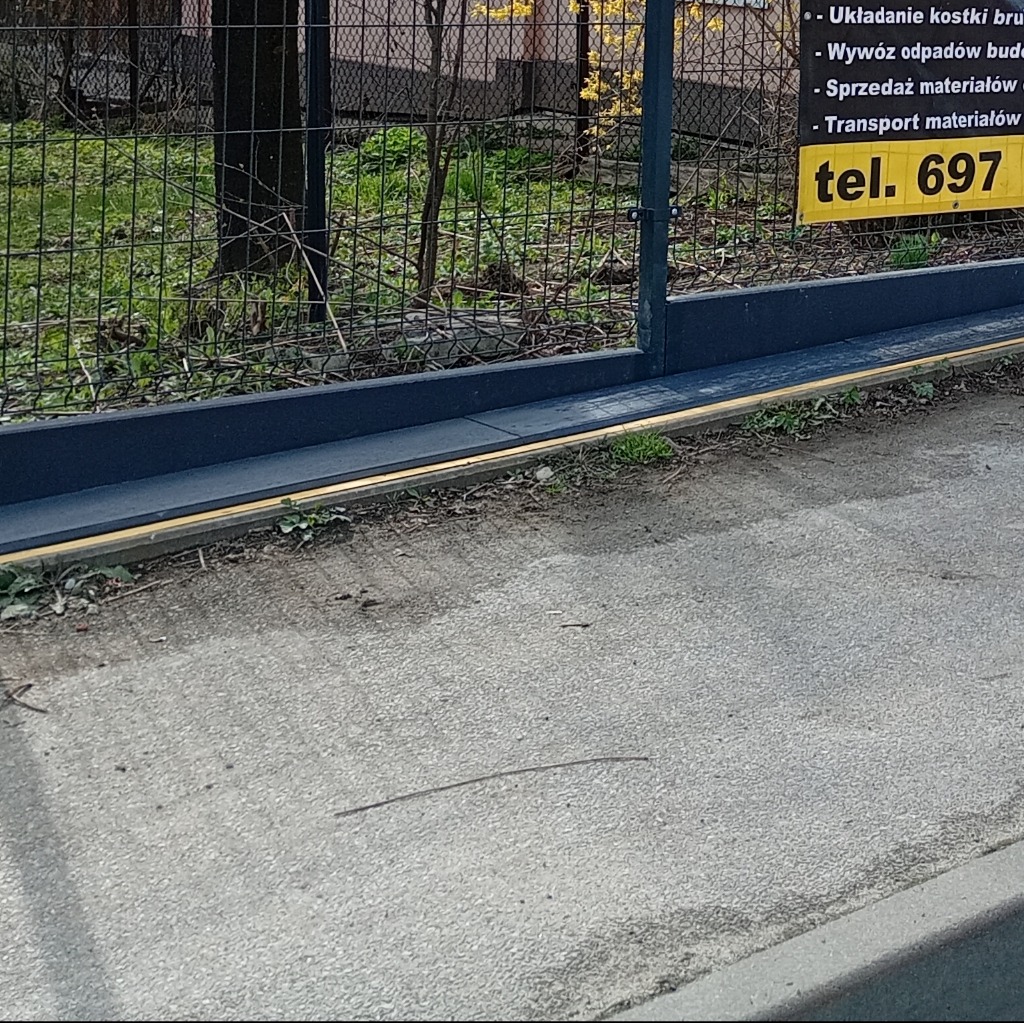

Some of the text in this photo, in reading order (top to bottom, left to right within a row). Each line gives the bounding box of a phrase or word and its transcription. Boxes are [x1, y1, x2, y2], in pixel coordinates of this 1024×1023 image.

[829, 6, 924, 24] Układanie
[929, 7, 989, 25] kostki
[827, 42, 896, 65] Wywóz
[900, 42, 982, 64] odpadów
[825, 77, 915, 101] Sprzedaż
[919, 75, 1018, 95] materiałów
[824, 113, 920, 136] Transport
[925, 110, 1022, 130] materiałów
[814, 156, 897, 203] tel.
[917, 150, 1003, 196] 697
